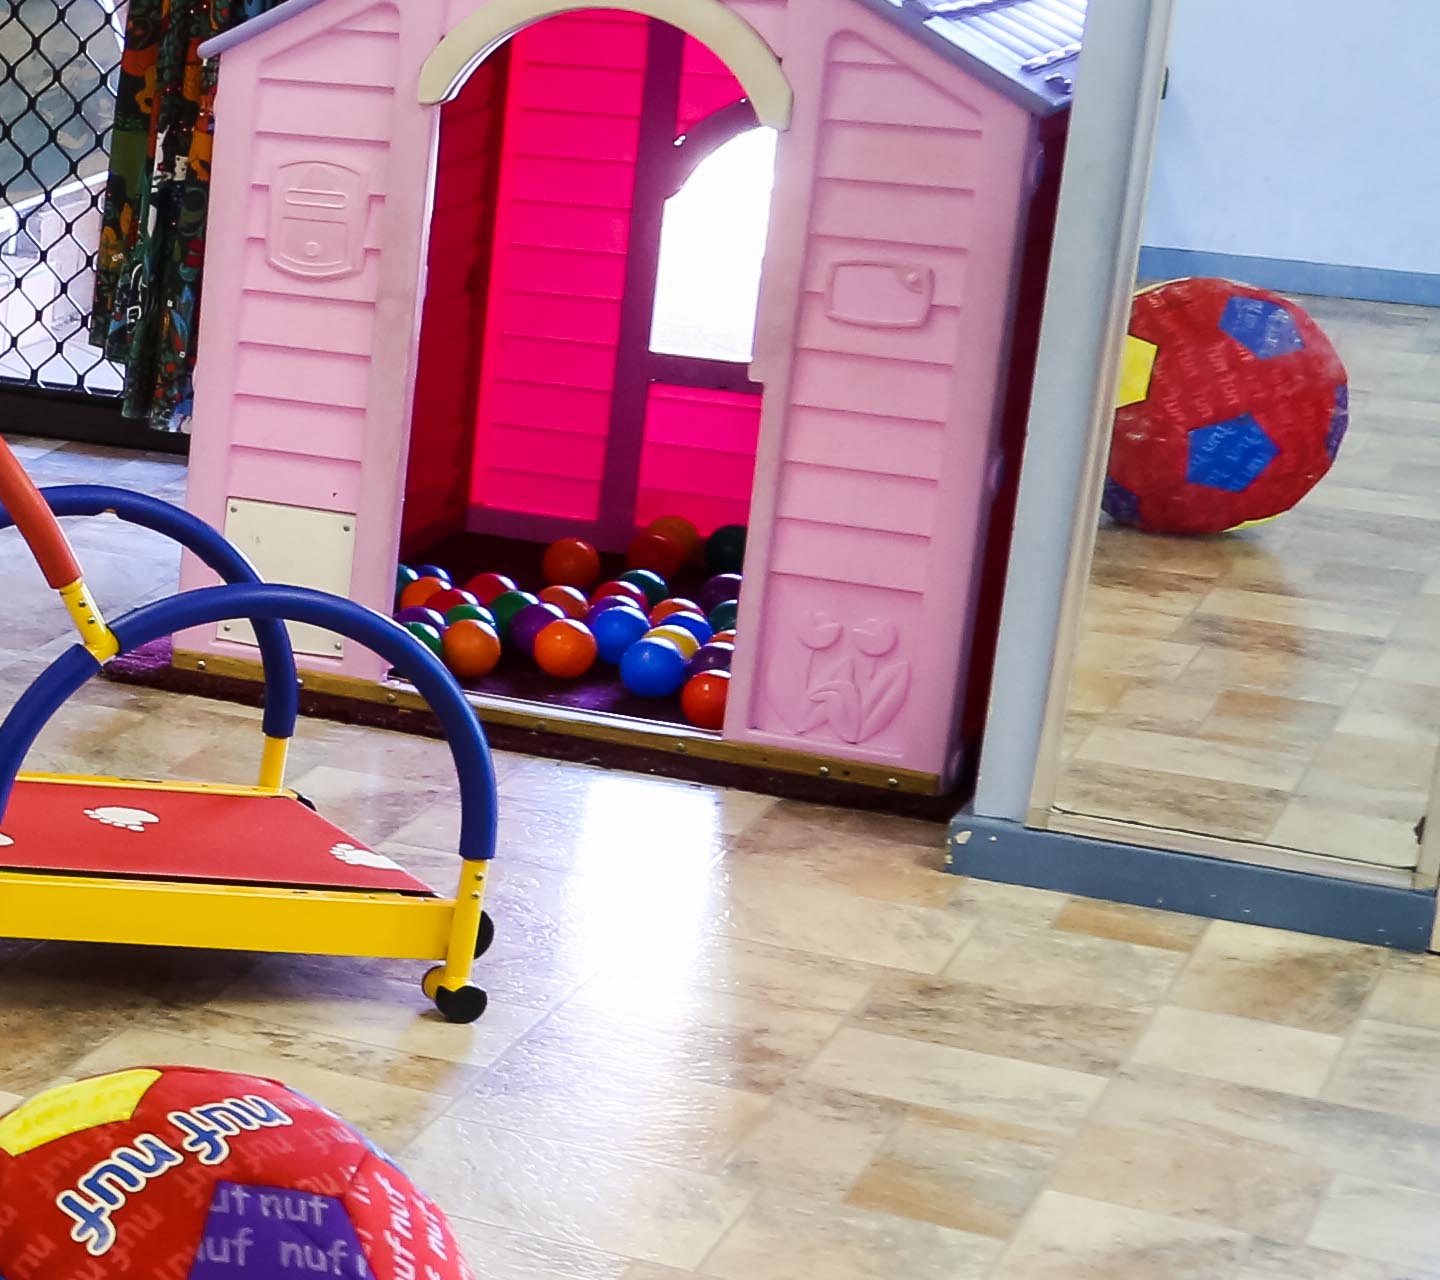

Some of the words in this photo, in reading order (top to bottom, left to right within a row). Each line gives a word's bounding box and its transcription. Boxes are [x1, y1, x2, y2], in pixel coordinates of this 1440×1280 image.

[168, 1094, 293, 1166] nuf
[55, 1133, 184, 1256] nuf
[375, 1172, 409, 1240] nuf
[280, 1240, 348, 1276] nuf
